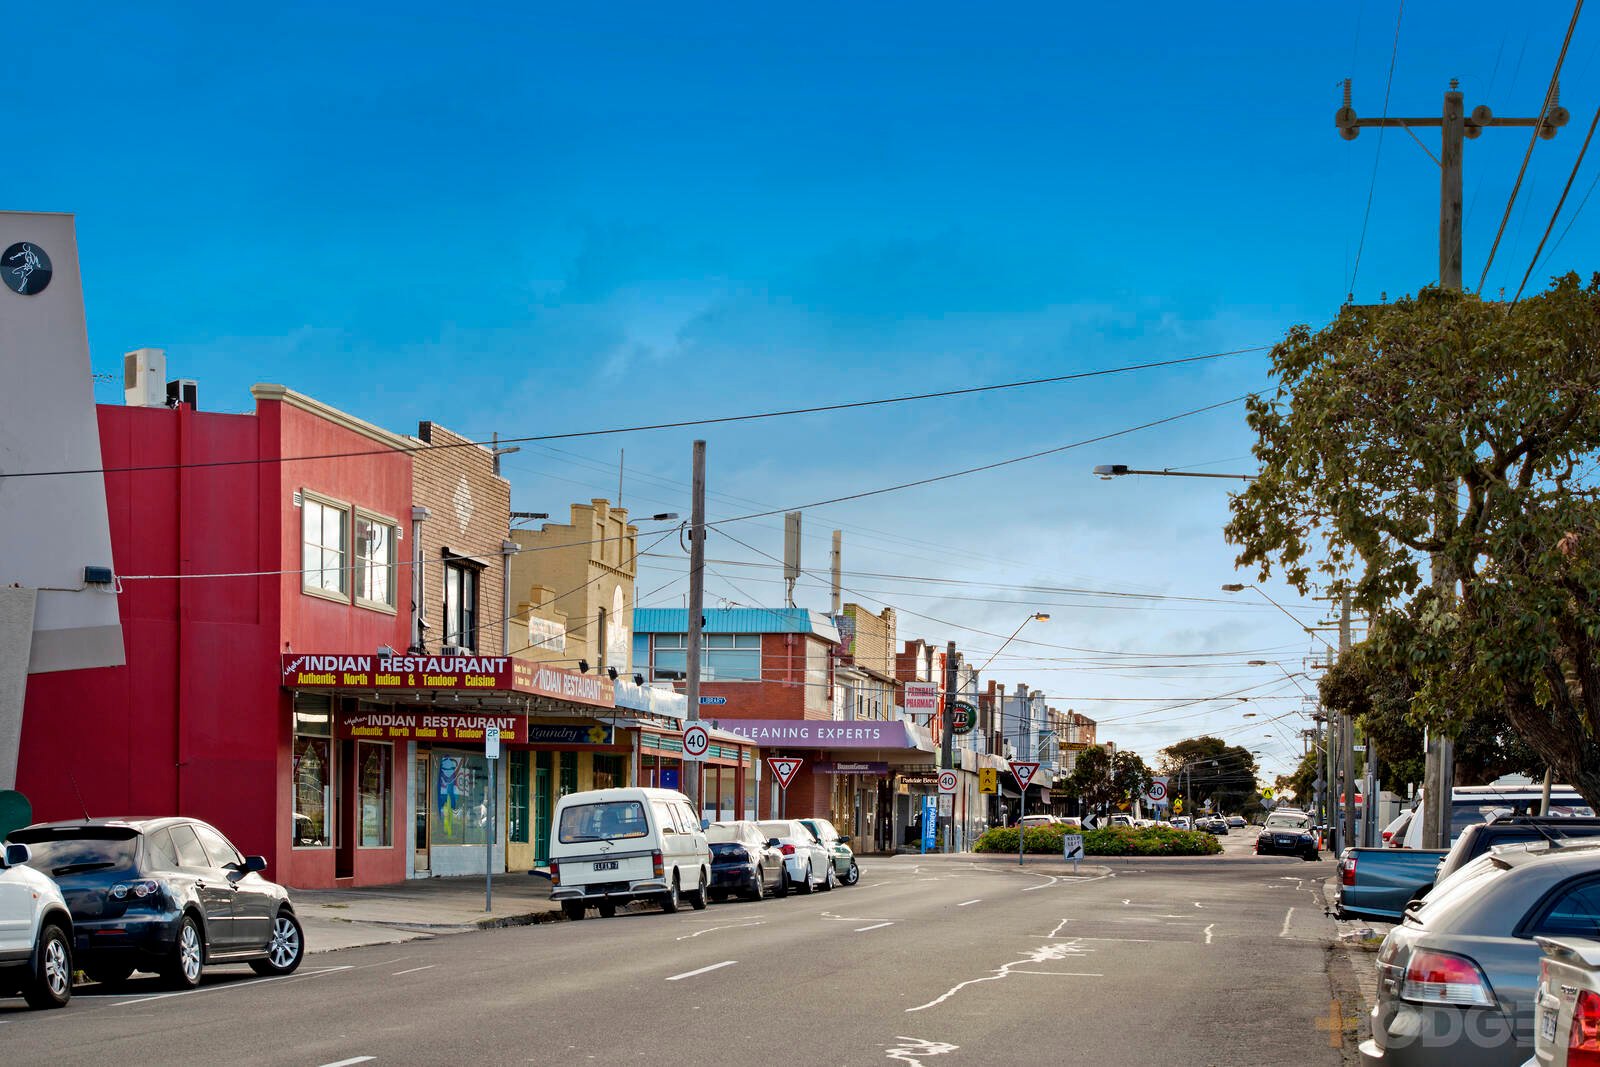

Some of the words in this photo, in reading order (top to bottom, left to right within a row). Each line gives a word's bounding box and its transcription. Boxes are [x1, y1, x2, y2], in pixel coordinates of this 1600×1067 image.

[305, 656, 371, 671] INDIAN
[380, 657, 507, 673] RESTAURANT
[298, 673, 336, 685] Authentic
[344, 674, 368, 685] North
[375, 674, 401, 686] Indian
[408, 674, 415, 685] &
[423, 674, 458, 687] Tandoor
[465, 675, 496, 687] Cuisine
[539, 669, 562, 693] INDIAN
[563, 674, 602, 700] RESTAURANT
[906, 699, 935, 708] PHARMACY
[367, 715, 416, 726] INDIAN
[423, 716, 516, 729] RESTAURANT
[351, 726, 383, 736] Authentic
[389, 727, 410, 736] North
[415, 727, 437, 737] Indian
[442, 727, 449, 738] &
[455, 728, 484, 739] Tandoor
[487, 729, 499, 738] 2P
[530, 727, 577, 741] Laundry
[733, 727, 809, 739] CLEANING
[818, 728, 880, 739] EXPERTS
[688, 734, 705, 748] 40
[942, 777, 954, 786] 40
[1149, 786, 1163, 796] 40
